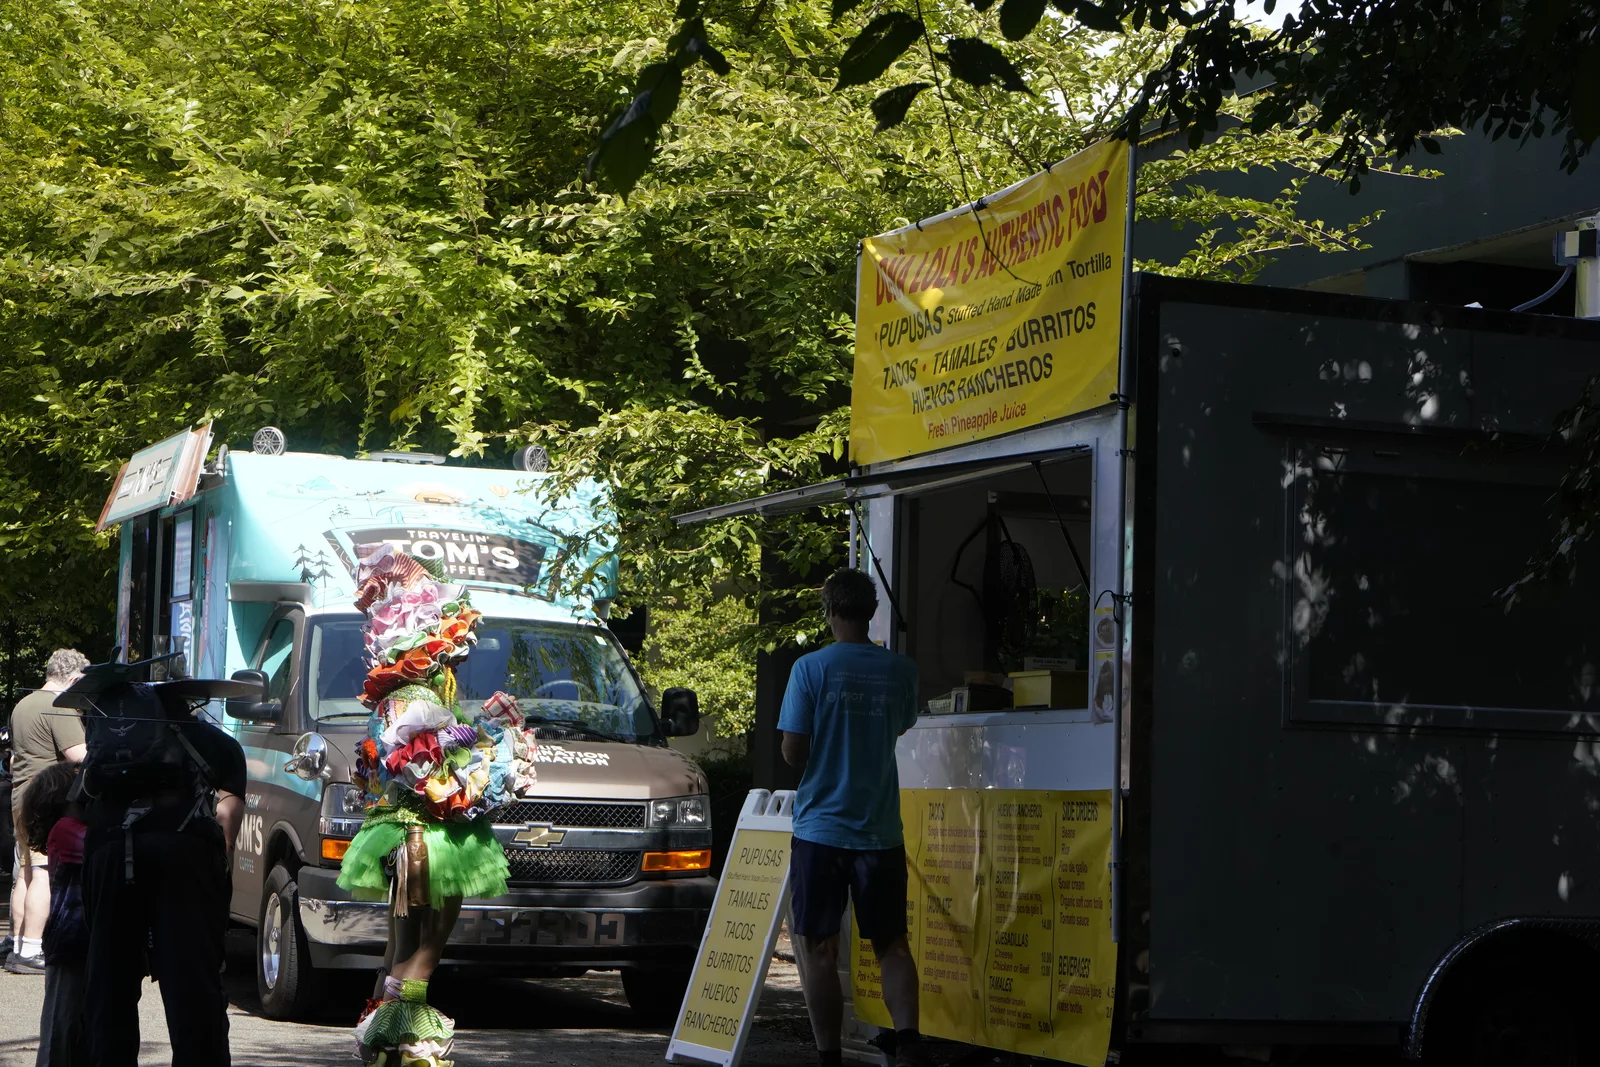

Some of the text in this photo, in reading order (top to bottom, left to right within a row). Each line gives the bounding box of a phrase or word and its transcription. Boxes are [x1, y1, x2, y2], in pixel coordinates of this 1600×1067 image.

[909, 235, 979, 292] LOLA'S
[974, 195, 1064, 281] AUTHENTIC
[879, 252, 1112, 350] PUPUSAS Stuffed Hand Made orn Tortilla
[883, 301, 1096, 390] TACOS TAMALES BURRITOS
[911, 353, 1053, 415] HUEVOS RANCHEROS
[928, 401, 1027, 440] Fresh Pineapple Juice
[407, 530, 489, 543] TRAVELIN'
[382, 538, 520, 570] TOM'S
[443, 565, 486, 577] OFFEE
[928, 803, 945, 821] TACOS
[1014, 804, 1043, 818] ANCHEROS
[1062, 801, 1098, 822] SIDE ORDERS
[235, 813, 263, 856] OM'S
[1061, 826, 1075, 838] Beans
[738, 847, 784, 867] PUPUSAS
[1069, 861, 1075, 872] de
[1058, 876, 1085, 890] Sour cream
[728, 889, 771, 911] TAMALES
[1060, 912, 1089, 926] Tomato sauce
[724, 920, 756, 941] TACOS
[995, 931, 1029, 947] QUESADILLAS
[706, 950, 753, 974] BURRITOS
[995, 948, 1013, 959] Cheese
[992, 960, 1012, 972] Chicken
[1013, 965, 1019, 973] or
[1019, 963, 1030, 974] Beef
[1058, 955, 1091, 979] BEVERAGES
[870, 972, 882, 984] Chees
[989, 975, 1013, 992] TAMALES
[701, 982, 740, 1004] HUEVOS
[684, 1010, 738, 1037] RANCHEROS
